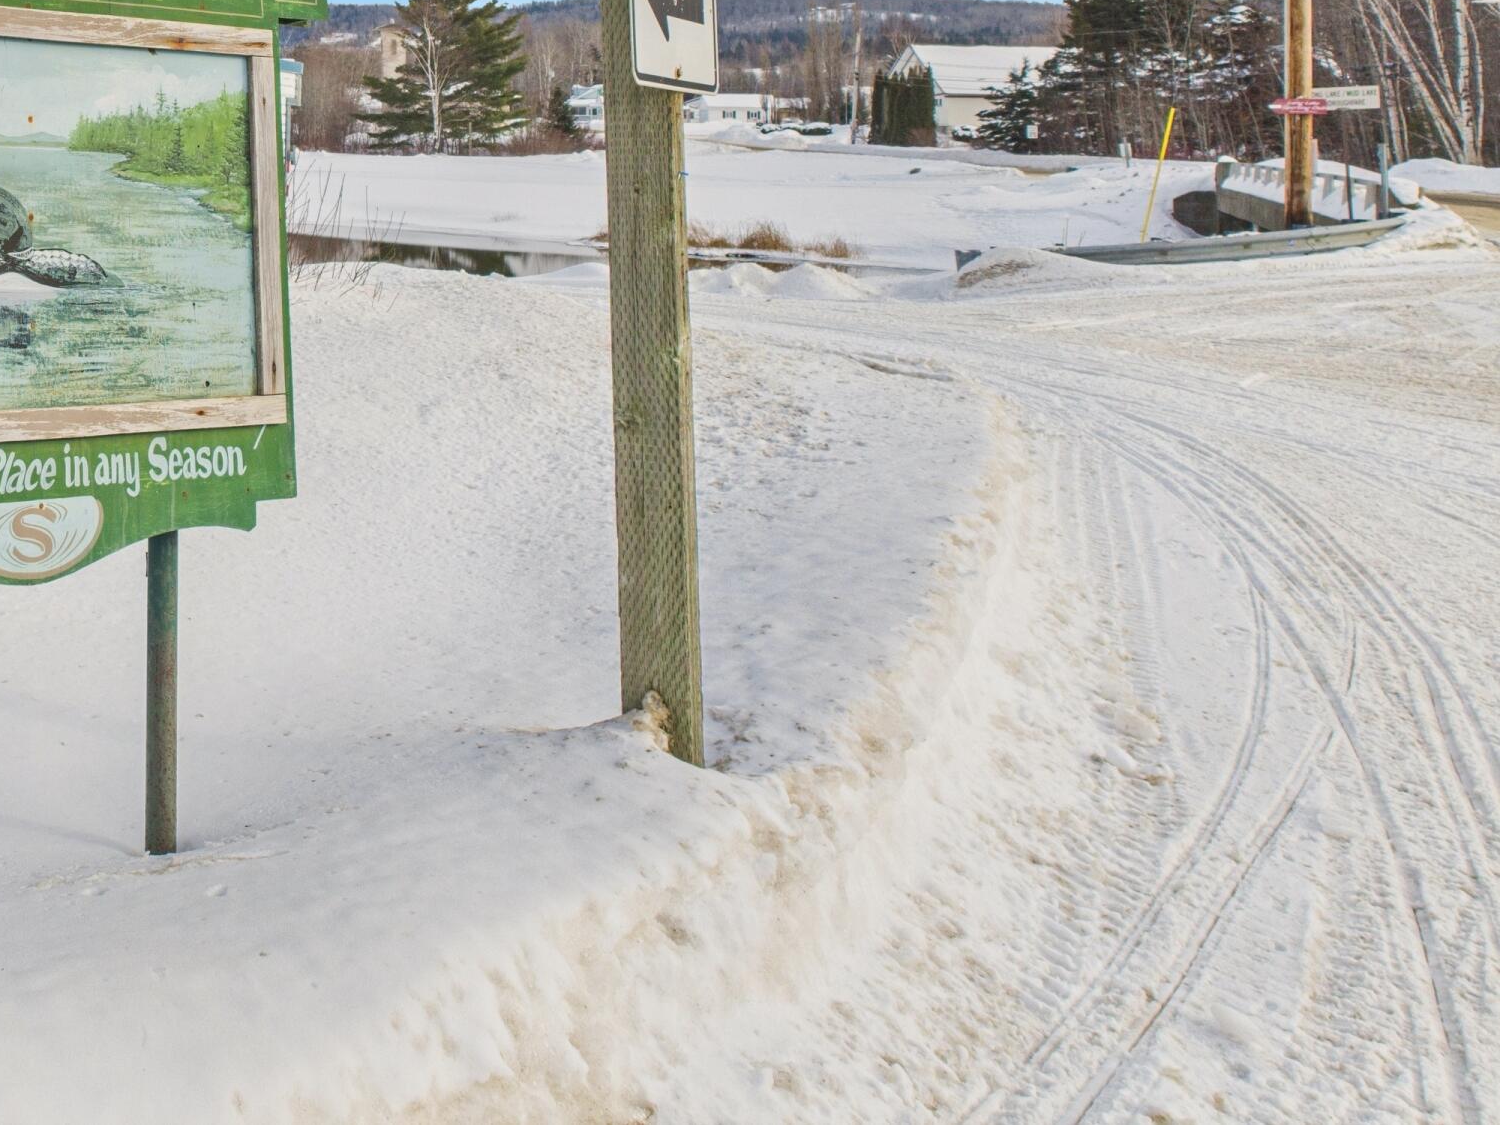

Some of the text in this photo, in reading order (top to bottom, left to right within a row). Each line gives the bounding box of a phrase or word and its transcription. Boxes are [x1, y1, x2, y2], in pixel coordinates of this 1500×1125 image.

[64, 443, 88, 488] in
[95, 450, 140, 498] any
[147, 437, 247, 483] Season
